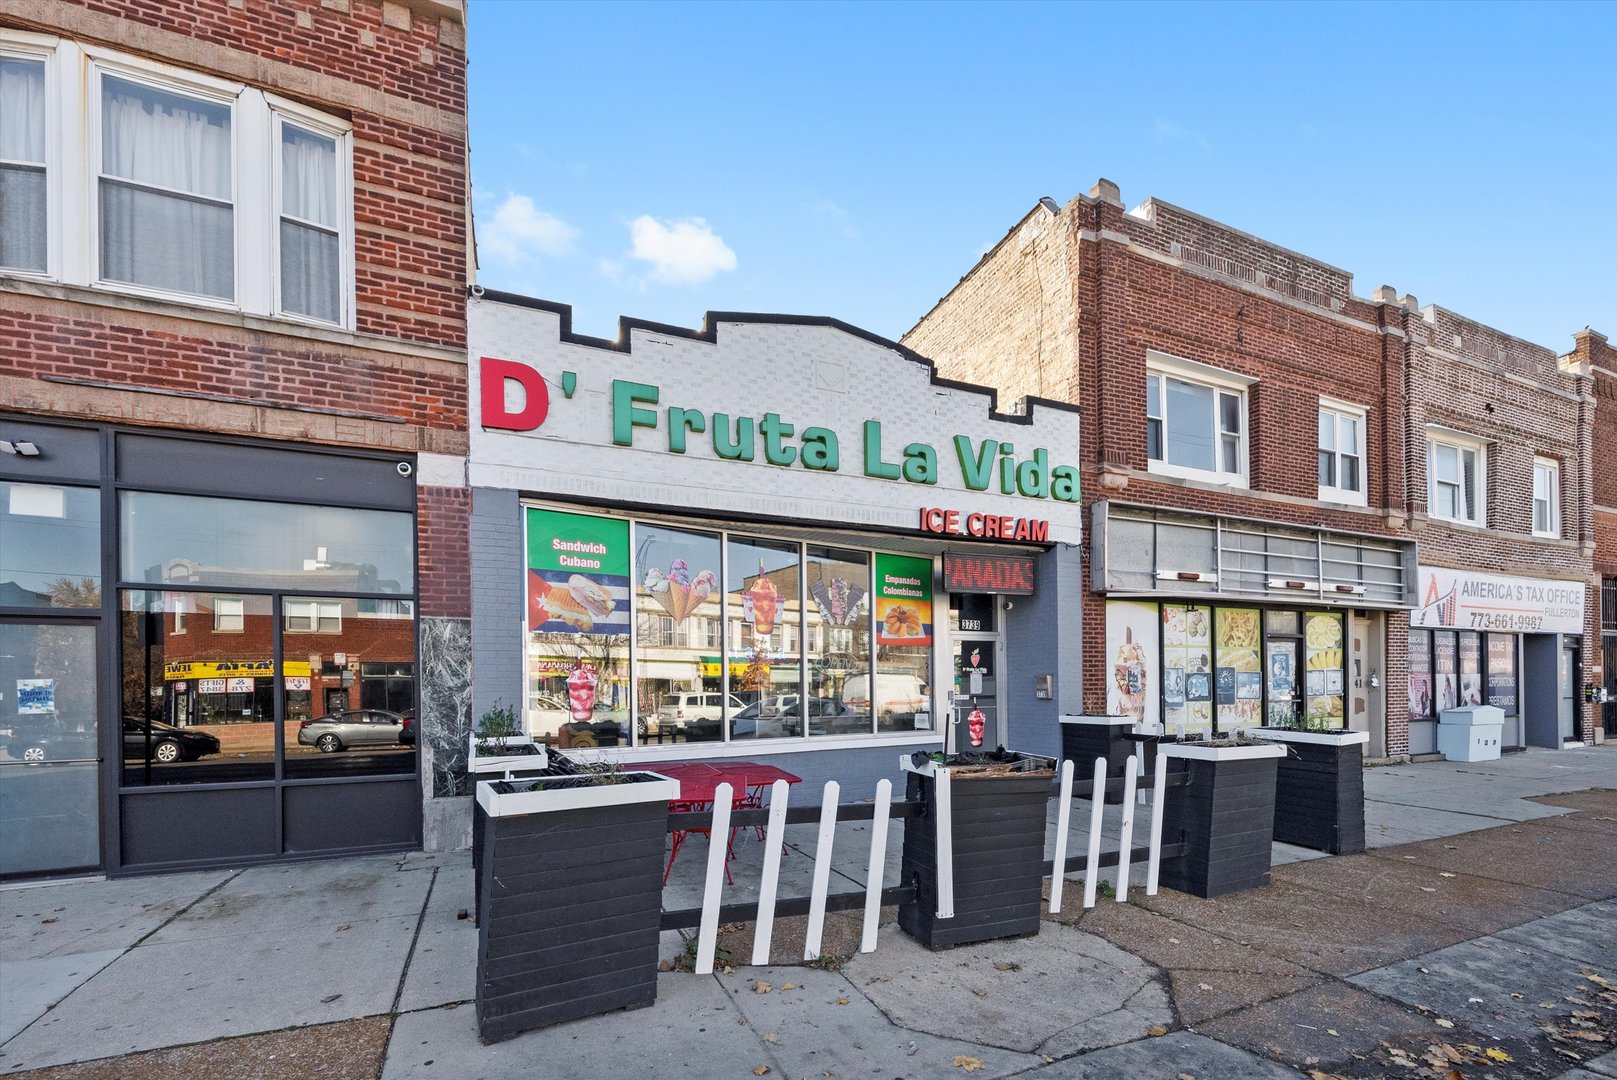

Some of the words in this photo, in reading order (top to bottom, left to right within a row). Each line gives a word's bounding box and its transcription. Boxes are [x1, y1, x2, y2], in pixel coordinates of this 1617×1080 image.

[480, 356, 577, 432] D'
[612, 378, 839, 472] Fruta
[863, 419, 938, 485] La
[953, 434, 1081, 503] Vida
[920, 507, 960, 534] ICE
[967, 512, 1049, 542] CREAM
[552, 538, 606, 554] Sandwich
[559, 554, 601, 568] Cubano
[885, 574, 921, 586] Empanadas
[883, 586, 923, 597] Colombianas
[1526, 586, 1545, 603] TAX
[1547, 588, 1581, 605] OFFICE
[1544, 607, 1580, 619] FULLERTON
[962, 619, 980, 630] 3739
[1470, 612, 1544, 630] 773-661-9987
[1435, 637, 1456, 646] USINESS
[1488, 641, 1505, 652] NCOME
